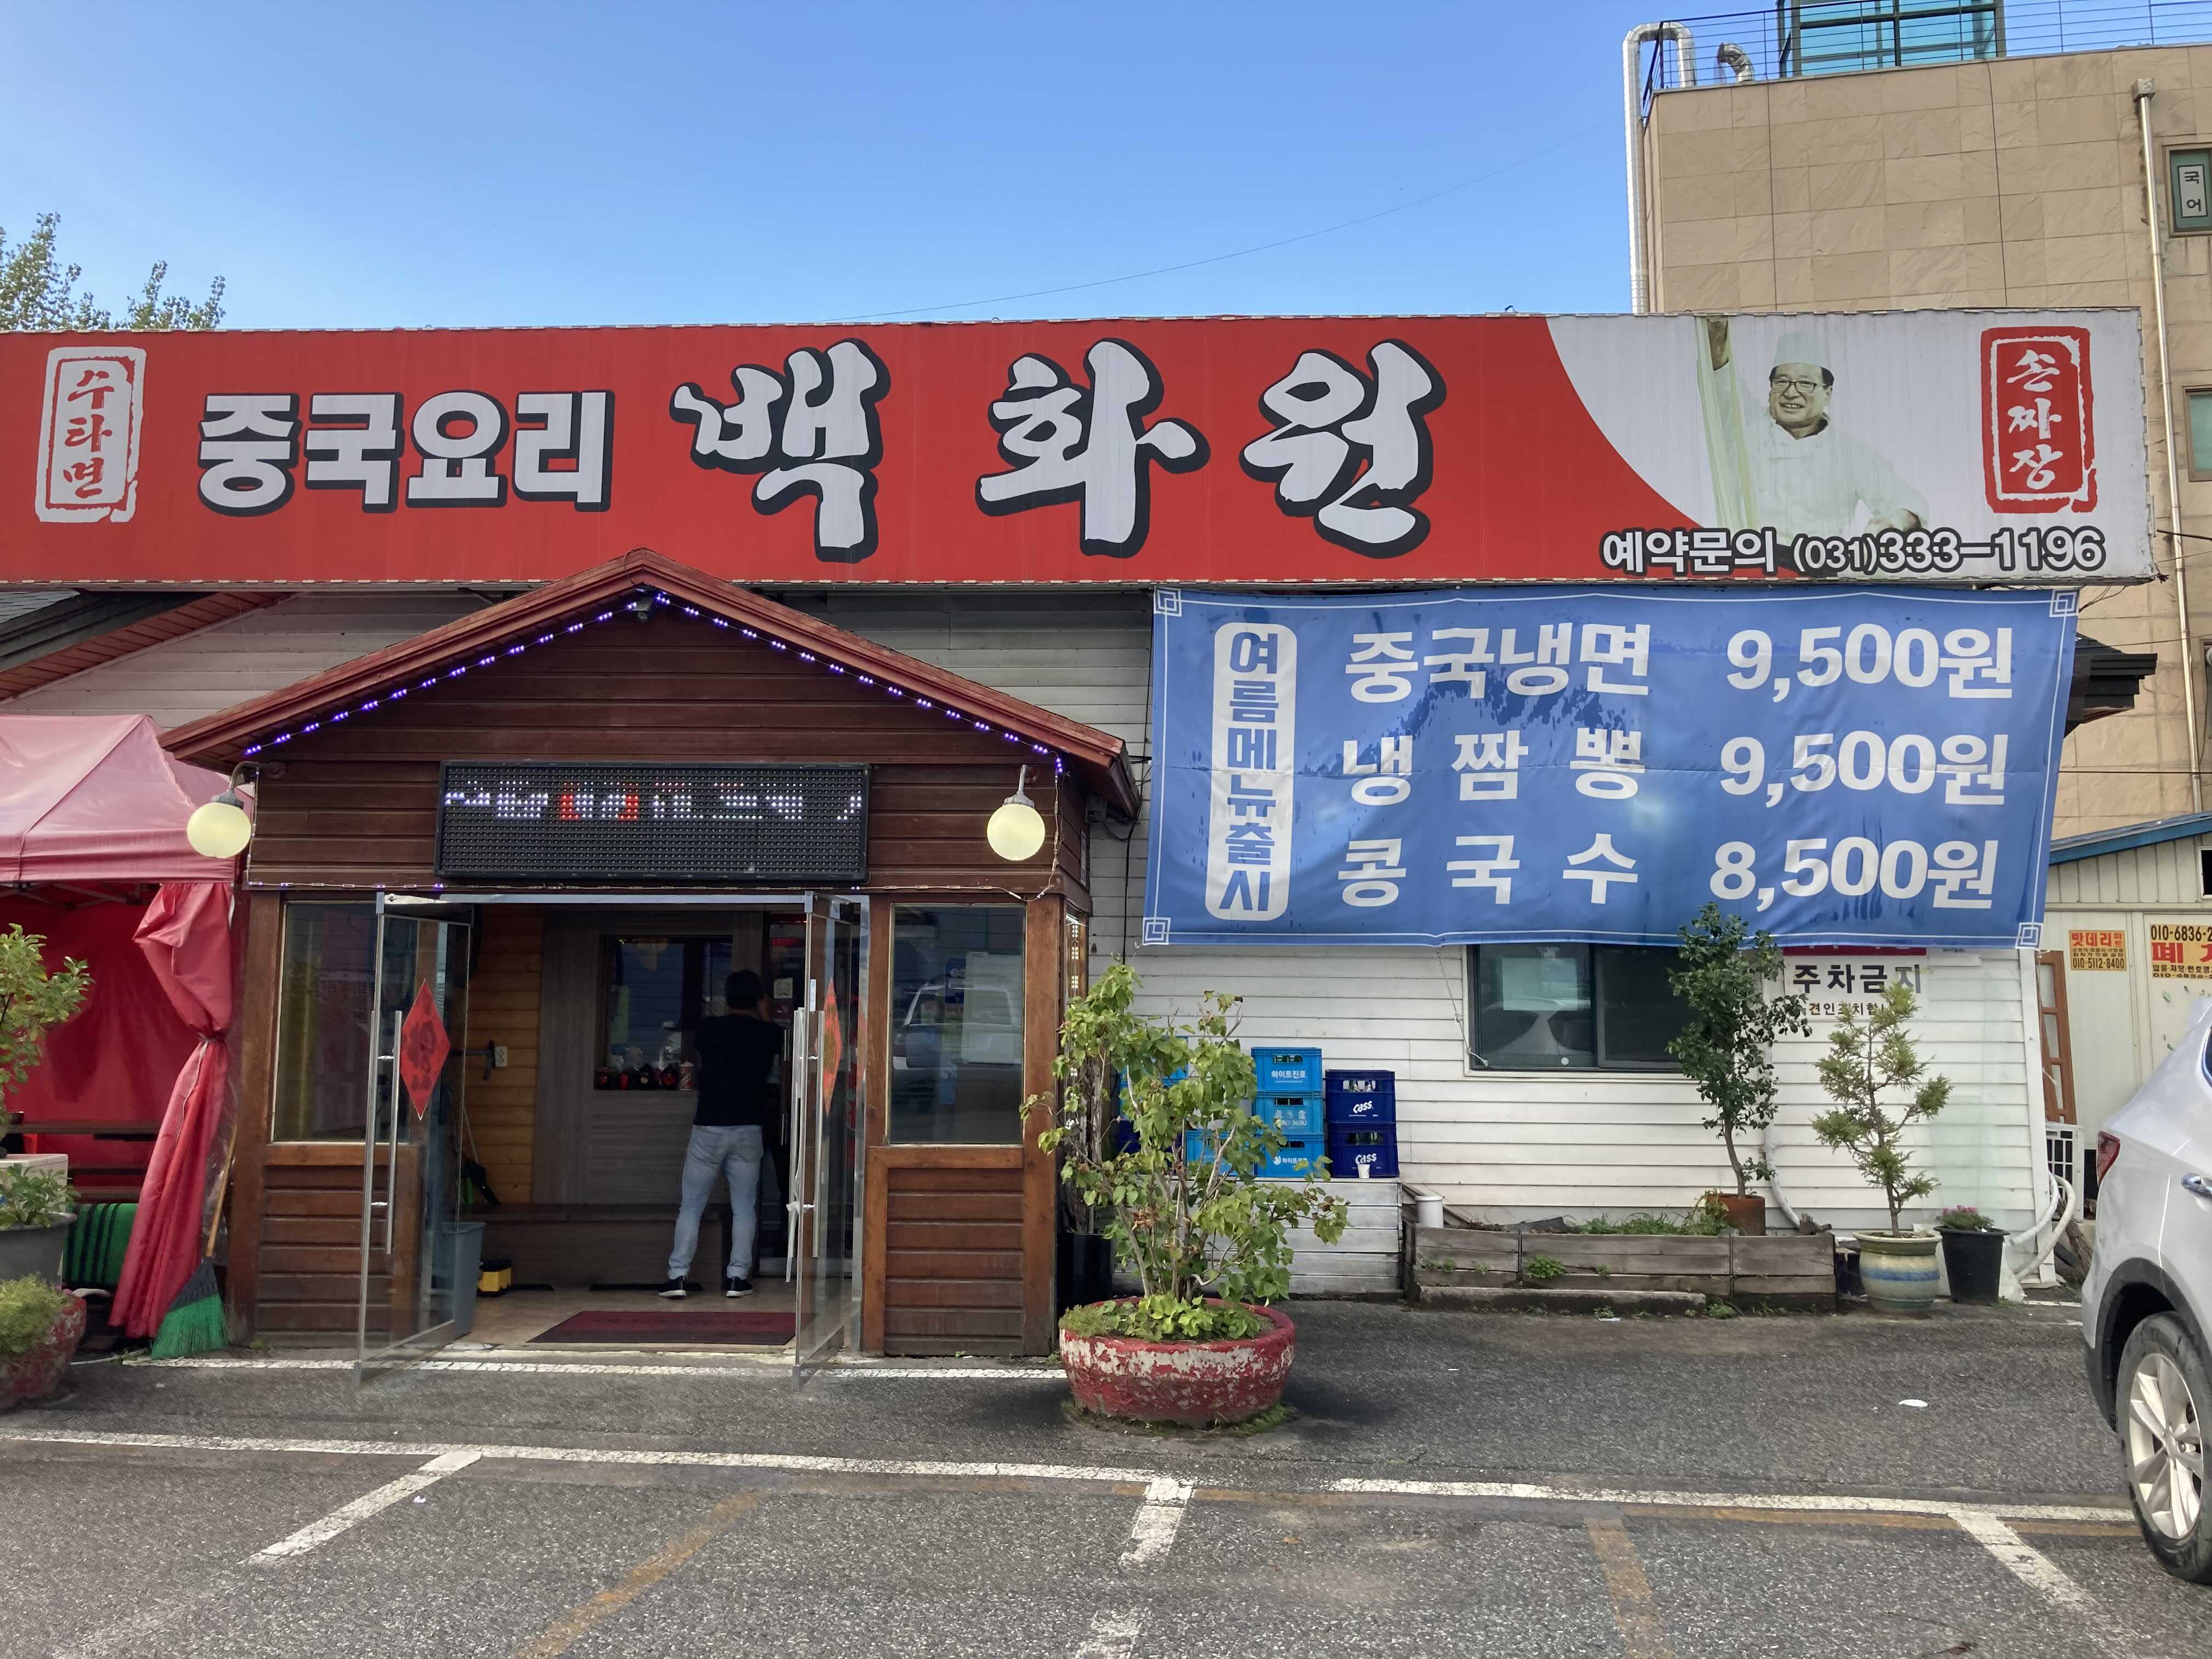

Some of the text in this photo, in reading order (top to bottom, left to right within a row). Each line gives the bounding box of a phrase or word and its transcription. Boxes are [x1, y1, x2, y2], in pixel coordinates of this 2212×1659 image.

[2184, 171, 2202, 212] 국어
[63, 369, 115, 499] 수타면
[199, 338, 1447, 562] 중국요리 백화원
[2006, 348, 2063, 490] 손짜장
[1599, 527, 1776, 574] 예약문의
[1345, 622, 2013, 703] 중국냉면 9,500원
[1218, 631, 1278, 912] 여름메뉴출시
[1719, 730, 2009, 809] 9,500원
[1708, 836, 1999, 913] 8,500원
[1793, 964, 1921, 994] 주차금지
[2073, 957, 2125, 969] 010-5112-8400
[1271, 1070, 1306, 1079] 하이트진로
[1353, 1101, 1373, 1114] Cass
[1355, 1153, 1377, 1164] Cass
